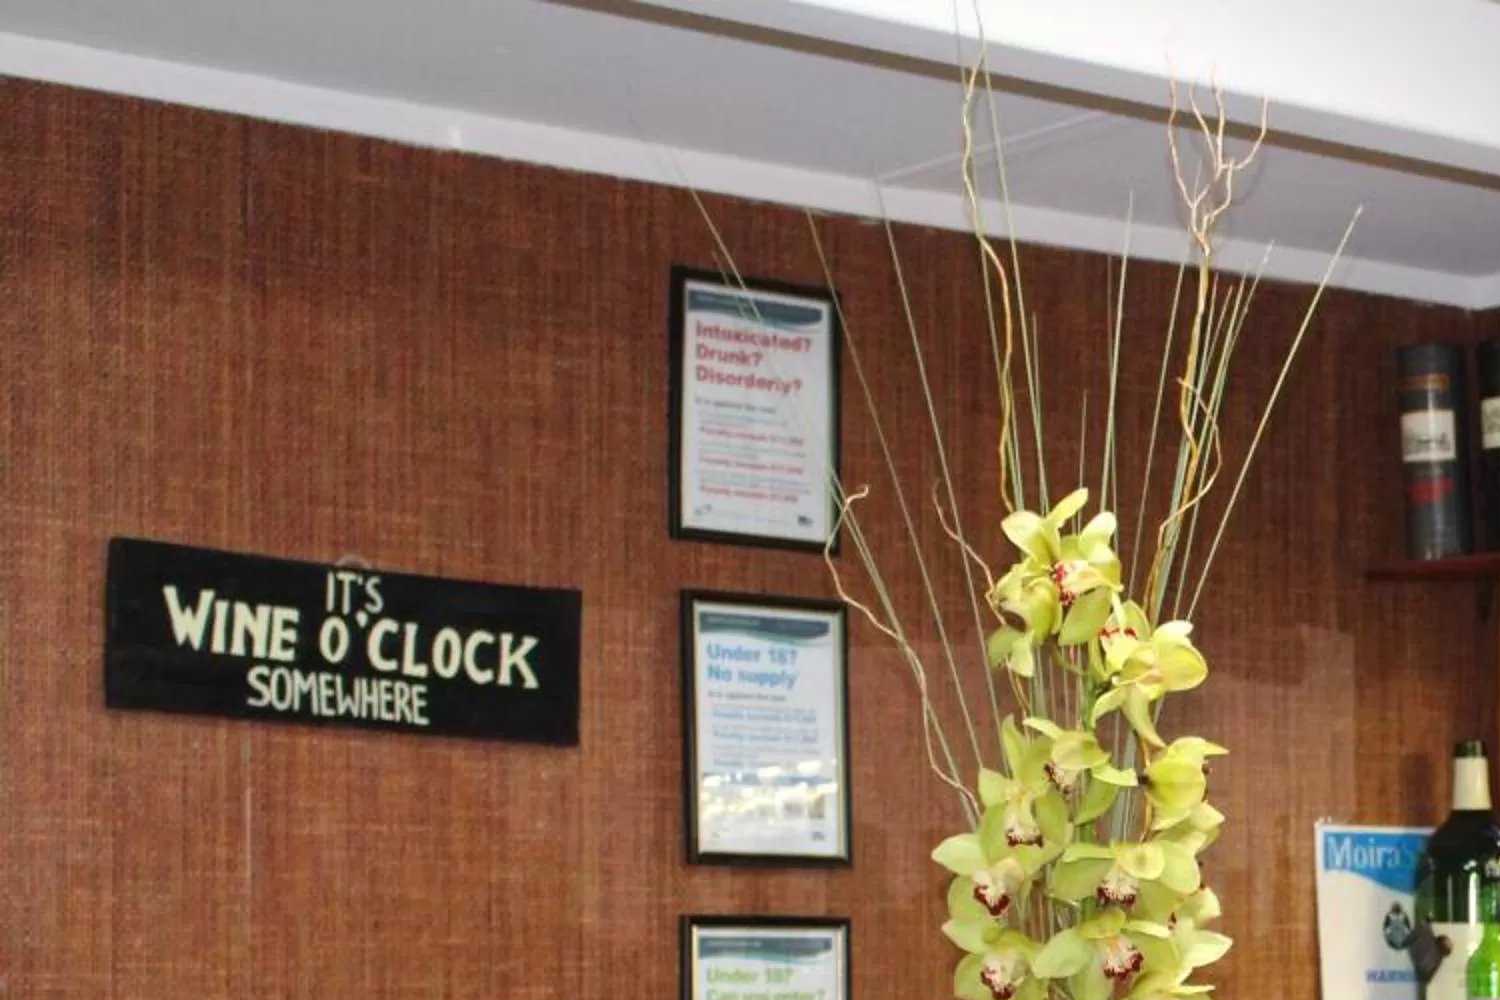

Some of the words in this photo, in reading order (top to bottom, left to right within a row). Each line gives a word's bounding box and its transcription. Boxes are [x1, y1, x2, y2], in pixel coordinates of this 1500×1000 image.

[696, 320, 812, 352] Intoxicated?
[696, 342, 764, 367] Drunk?
[695, 364, 803, 396] Disorderly?
[326, 571, 384, 615] IT'S
[162, 585, 299, 662] WINE
[319, 611, 540, 689] O'CLOCK
[706, 641, 761, 664] Under
[707, 664, 733, 683] No
[738, 667, 799, 691] supply
[248, 666, 430, 726] SOMEWHERE
[1327, 835, 1400, 869] Moira
[706, 967, 758, 985] Under
